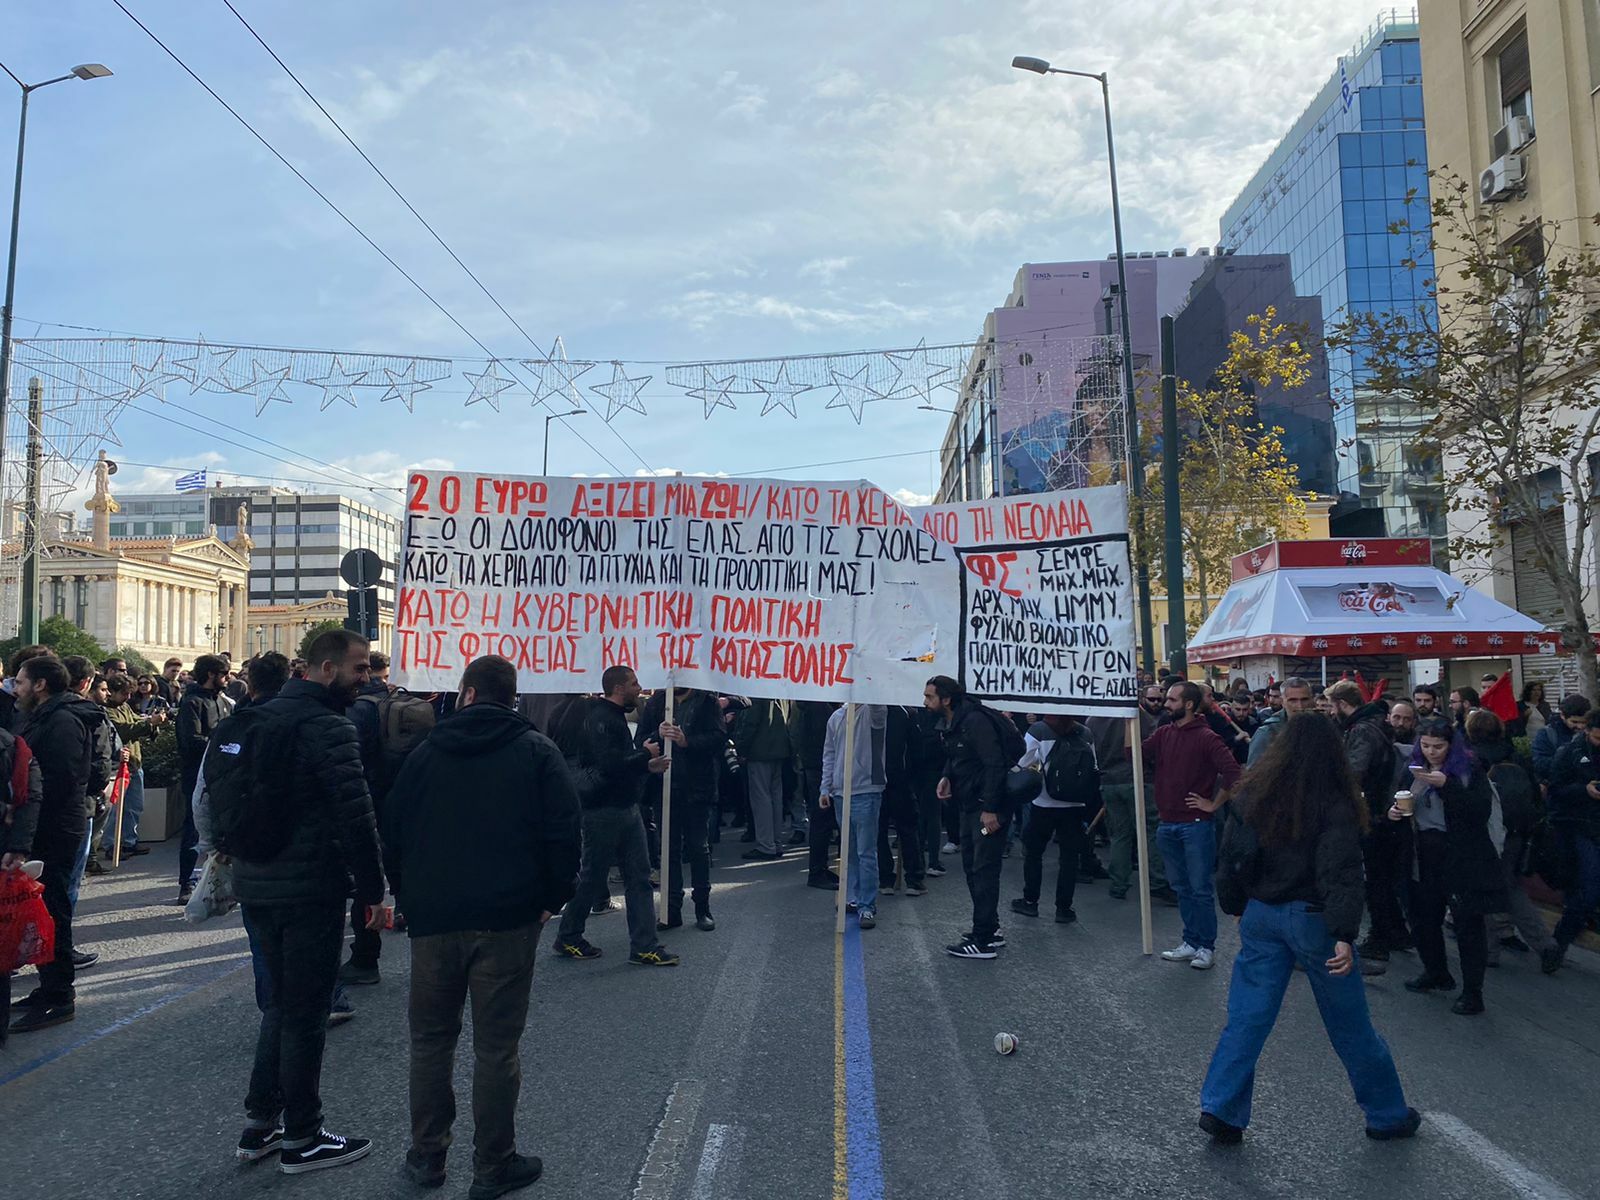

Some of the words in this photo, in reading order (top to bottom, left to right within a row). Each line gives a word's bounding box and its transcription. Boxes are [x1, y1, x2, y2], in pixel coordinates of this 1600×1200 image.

[474, 478, 548, 517] ΕΥΡΩ
[570, 481, 655, 518] ΑΞΙΖΕΙ
[664, 482, 697, 517] ΜΙΑ
[828, 489, 851, 525] ΤΑ
[923, 511, 959, 544] ΑΠΟ
[967, 507, 994, 542] ΤΗ
[1003, 499, 1093, 541] ΝΕΟΛΑΙΑ
[406, 515, 457, 549] ΕΞΩ
[469, 517, 491, 549] ΟΙ
[501, 517, 617, 552] ΔΟΛΟΦΟΝΟΙ
[633, 518, 674, 550] ΤΗΣ
[756, 524, 793, 556] ΑΠΟ
[802, 524, 840, 555] ΤΙΣ
[1036, 544, 1108, 573] ΣΕΜΦΕ
[403, 551, 448, 583] ΚΑΤΩ
[453, 552, 476, 586] ΤΑ
[480, 553, 528, 588] ΧΕΡΙΑ
[531, 554, 567, 587] ΑΠΟ
[577, 554, 597, 585] ΤΑ
[600, 554, 656, 585] ΠΤΥΧΙΑ
[660, 553, 682, 585] ΚΑΙ
[688, 555, 709, 588] ΤΗ
[714, 557, 808, 593] ΠΡΟΟΠΤΙΚΗ
[397, 587, 471, 628] ΚΑΤΩ
[480, 592, 503, 628] Η
[512, 590, 694, 635] ΚΥΒΕΡΝΗΤΙΚΗ
[710, 594, 822, 638] ΠΟΛΙΤΙΚΗ
[397, 629, 453, 673] ΤΗΣ
[602, 635, 639, 672] ΚΑΙ
[655, 632, 702, 669] ΤΗΣ
[710, 636, 854, 687] ΚΑΤΑΣΤΟΛΗΣ
